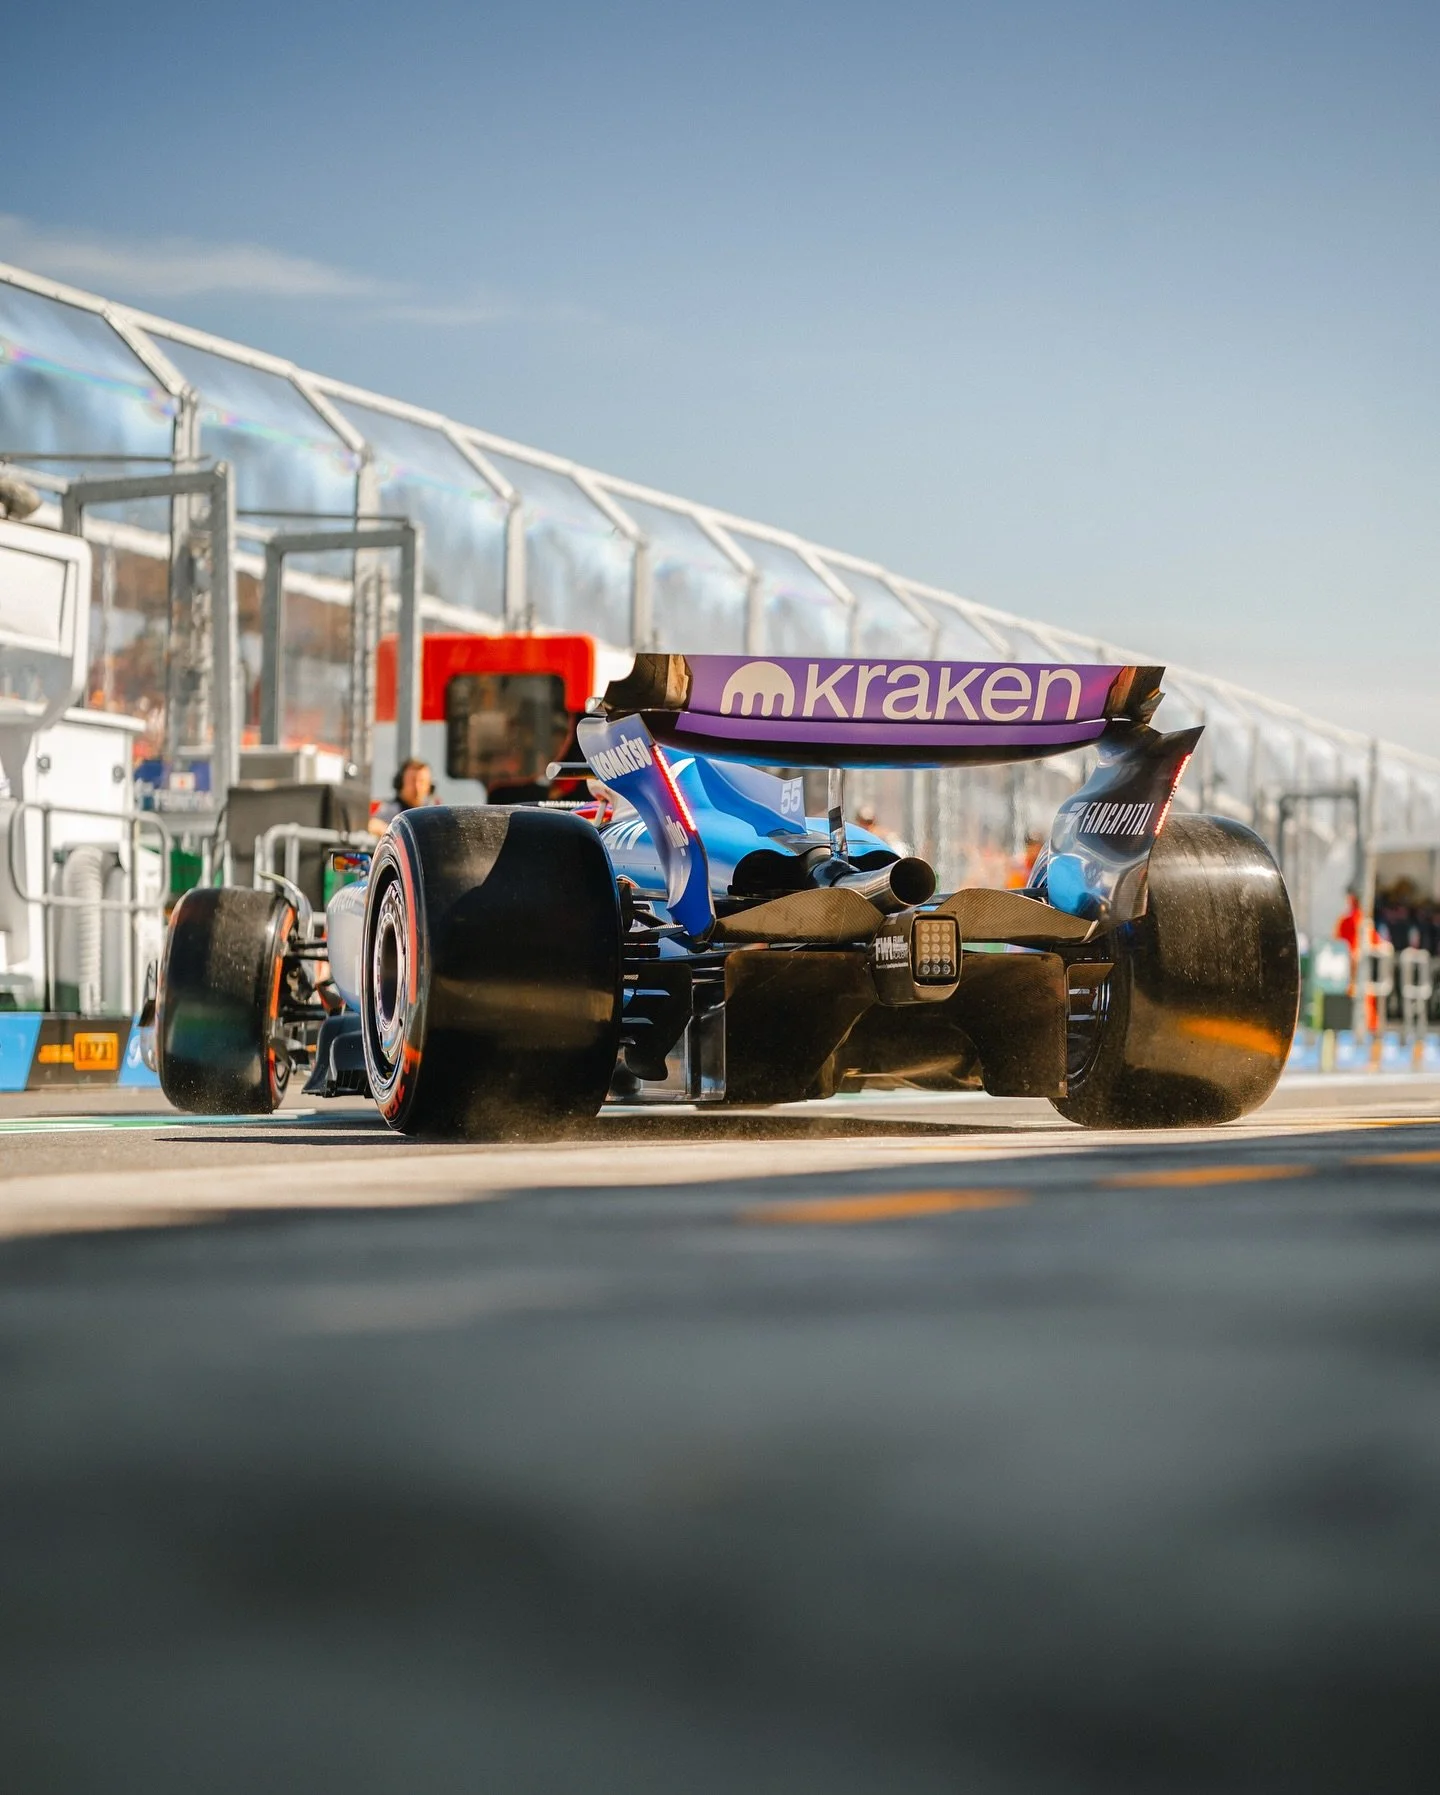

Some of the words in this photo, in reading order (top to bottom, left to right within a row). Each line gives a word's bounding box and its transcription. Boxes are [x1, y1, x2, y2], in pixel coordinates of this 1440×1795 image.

[589, 734, 653, 782] KOMATSU
[781, 779, 802, 815] 55
[1079, 802, 1154, 836] FANCAPITAL
